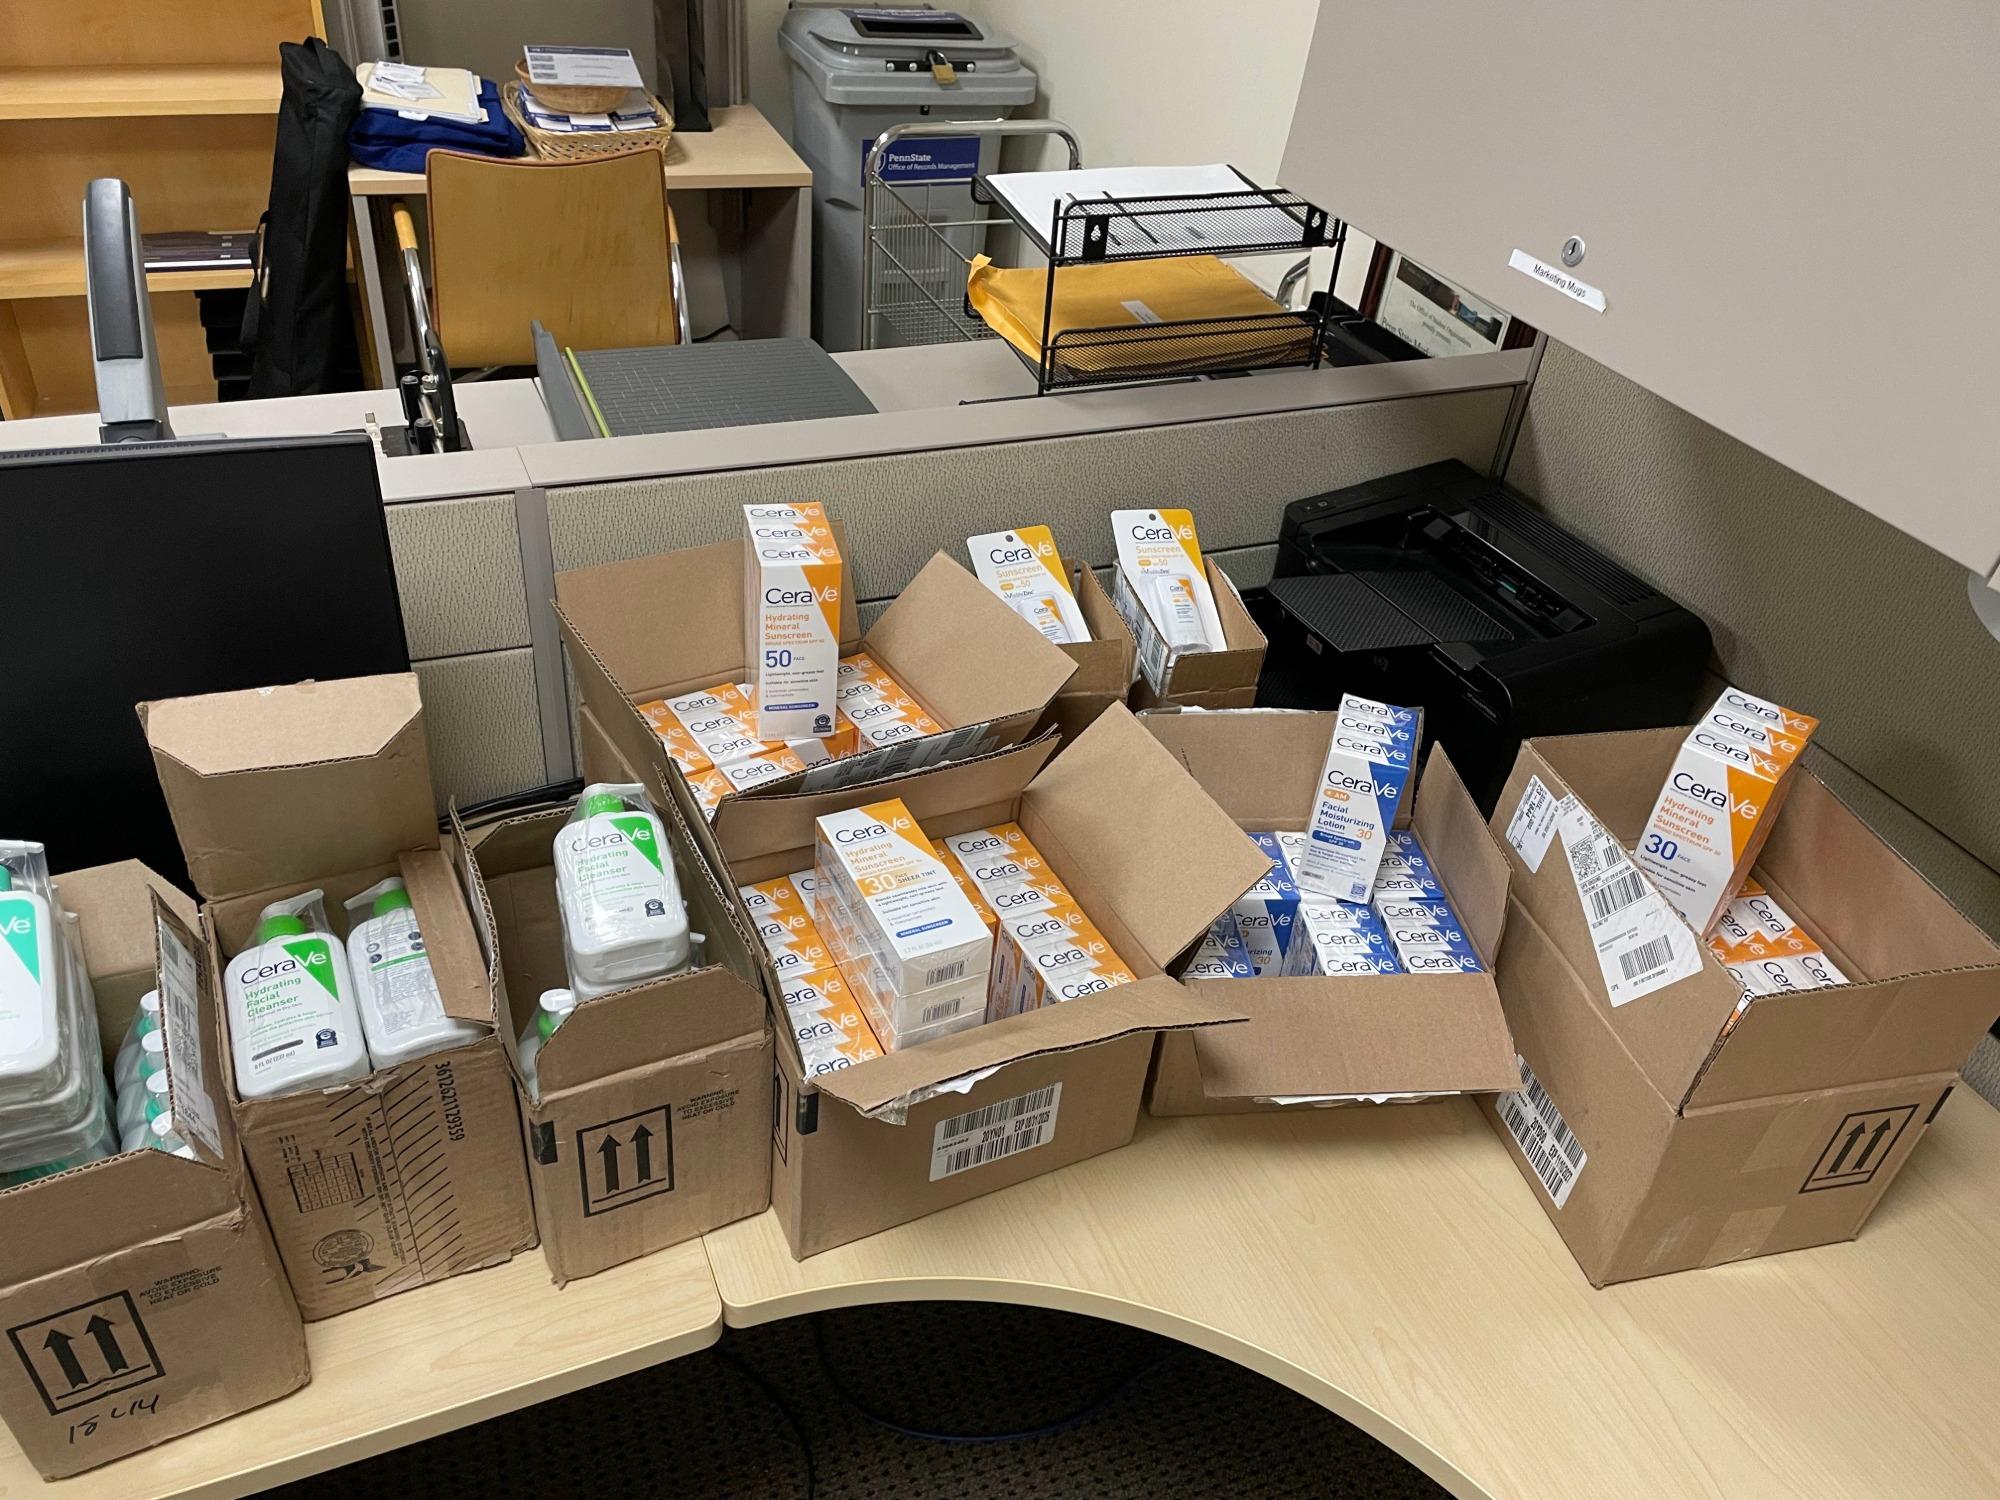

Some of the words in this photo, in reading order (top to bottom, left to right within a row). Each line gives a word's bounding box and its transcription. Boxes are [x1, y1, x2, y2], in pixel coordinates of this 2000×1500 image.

[889, 154, 931, 162] PennState
[938, 162, 975, 170] Management
[1533, 263, 1566, 289] Marketing
[1566, 280, 1586, 298] Mugs
[750, 507, 820, 518] CeraVe
[756, 526, 828, 538] CeraVe
[1132, 525, 1193, 541] CeraVe
[762, 547, 835, 558] CeraVe
[990, 541, 1053, 564] CeraVe
[1136, 546, 1181, 554] Sunscreen
[995, 565, 1043, 578] Sunscreen
[765, 586, 838, 604] CeraVe
[765, 632, 812, 640] Sunscreen
[765, 650, 792, 668] 50
[673, 690, 739, 712] CeraVe
[850, 696, 911, 720] CeraVe
[1345, 698, 1412, 721] CeraVe
[1727, 694, 1809, 732] CeraVe
[871, 717, 931, 741] CeraVe
[1341, 717, 1409, 740] CeraVe
[1713, 714, 1796, 753] CeraVe
[1337, 737, 1406, 761] CeraVe
[1695, 733, 1780, 774] CeraVe
[731, 756, 798, 780] CeraVe
[1328, 770, 1398, 798] CeraVe
[1673, 772, 1759, 820] CeraVe
[1322, 801, 1349, 814] Facial
[1661, 805, 1699, 828] Mineral
[1664, 796, 1714, 824] Hydrating
[835, 817, 911, 843] CeraVe
[1318, 818, 1345, 830] Lotion
[1320, 809, 1375, 830] Moisturizing
[1655, 815, 1709, 843] Sunscreen
[571, 827, 651, 852] CeraVe
[958, 831, 1021, 853] CeraVe
[1356, 829, 1372, 840] 30
[846, 841, 894, 858] Hydrating
[1645, 834, 1678, 860] 30
[576, 849, 629, 868] Hydrating
[578, 861, 608, 873] Facial
[851, 852, 887, 864] Mineral
[853, 855, 905, 873] Sunscreen
[976, 856, 1040, 880] CeraVe
[578, 866, 627, 881] Cleanser
[865, 873, 897, 894] 30
[921, 870, 937, 878] TINT
[995, 883, 1060, 908] CeraVe
[1309, 908, 1371, 919] CeraVe
[1384, 905, 1448, 917] CeraVe
[921, 920, 947, 929] SUNSCREEN
[1016, 912, 1083, 938] CeraVe
[1749, 899, 1804, 950] CeraVe
[1317, 932, 1382, 945] CeraVe
[1396, 930, 1461, 942] CeraVe
[1038, 940, 1105, 968] CeraVe
[1256, 956, 1271, 965] 30
[1409, 955, 1475, 968] CeraVe
[241, 951, 327, 984] CeraVe
[1327, 959, 1394, 972] CeraVe
[244, 976, 301, 1000] Hydrating
[784, 980, 842, 1004] eraVe
[1061, 969, 1128, 999] CeraVe
[246, 991, 281, 1008] Facial
[247, 996, 298, 1019] Cleanser
[798, 1013, 859, 1042] eraVe
[1014, 1119, 1025, 1132] EXP
[170, 1266, 222, 1286] EXPOSURE
